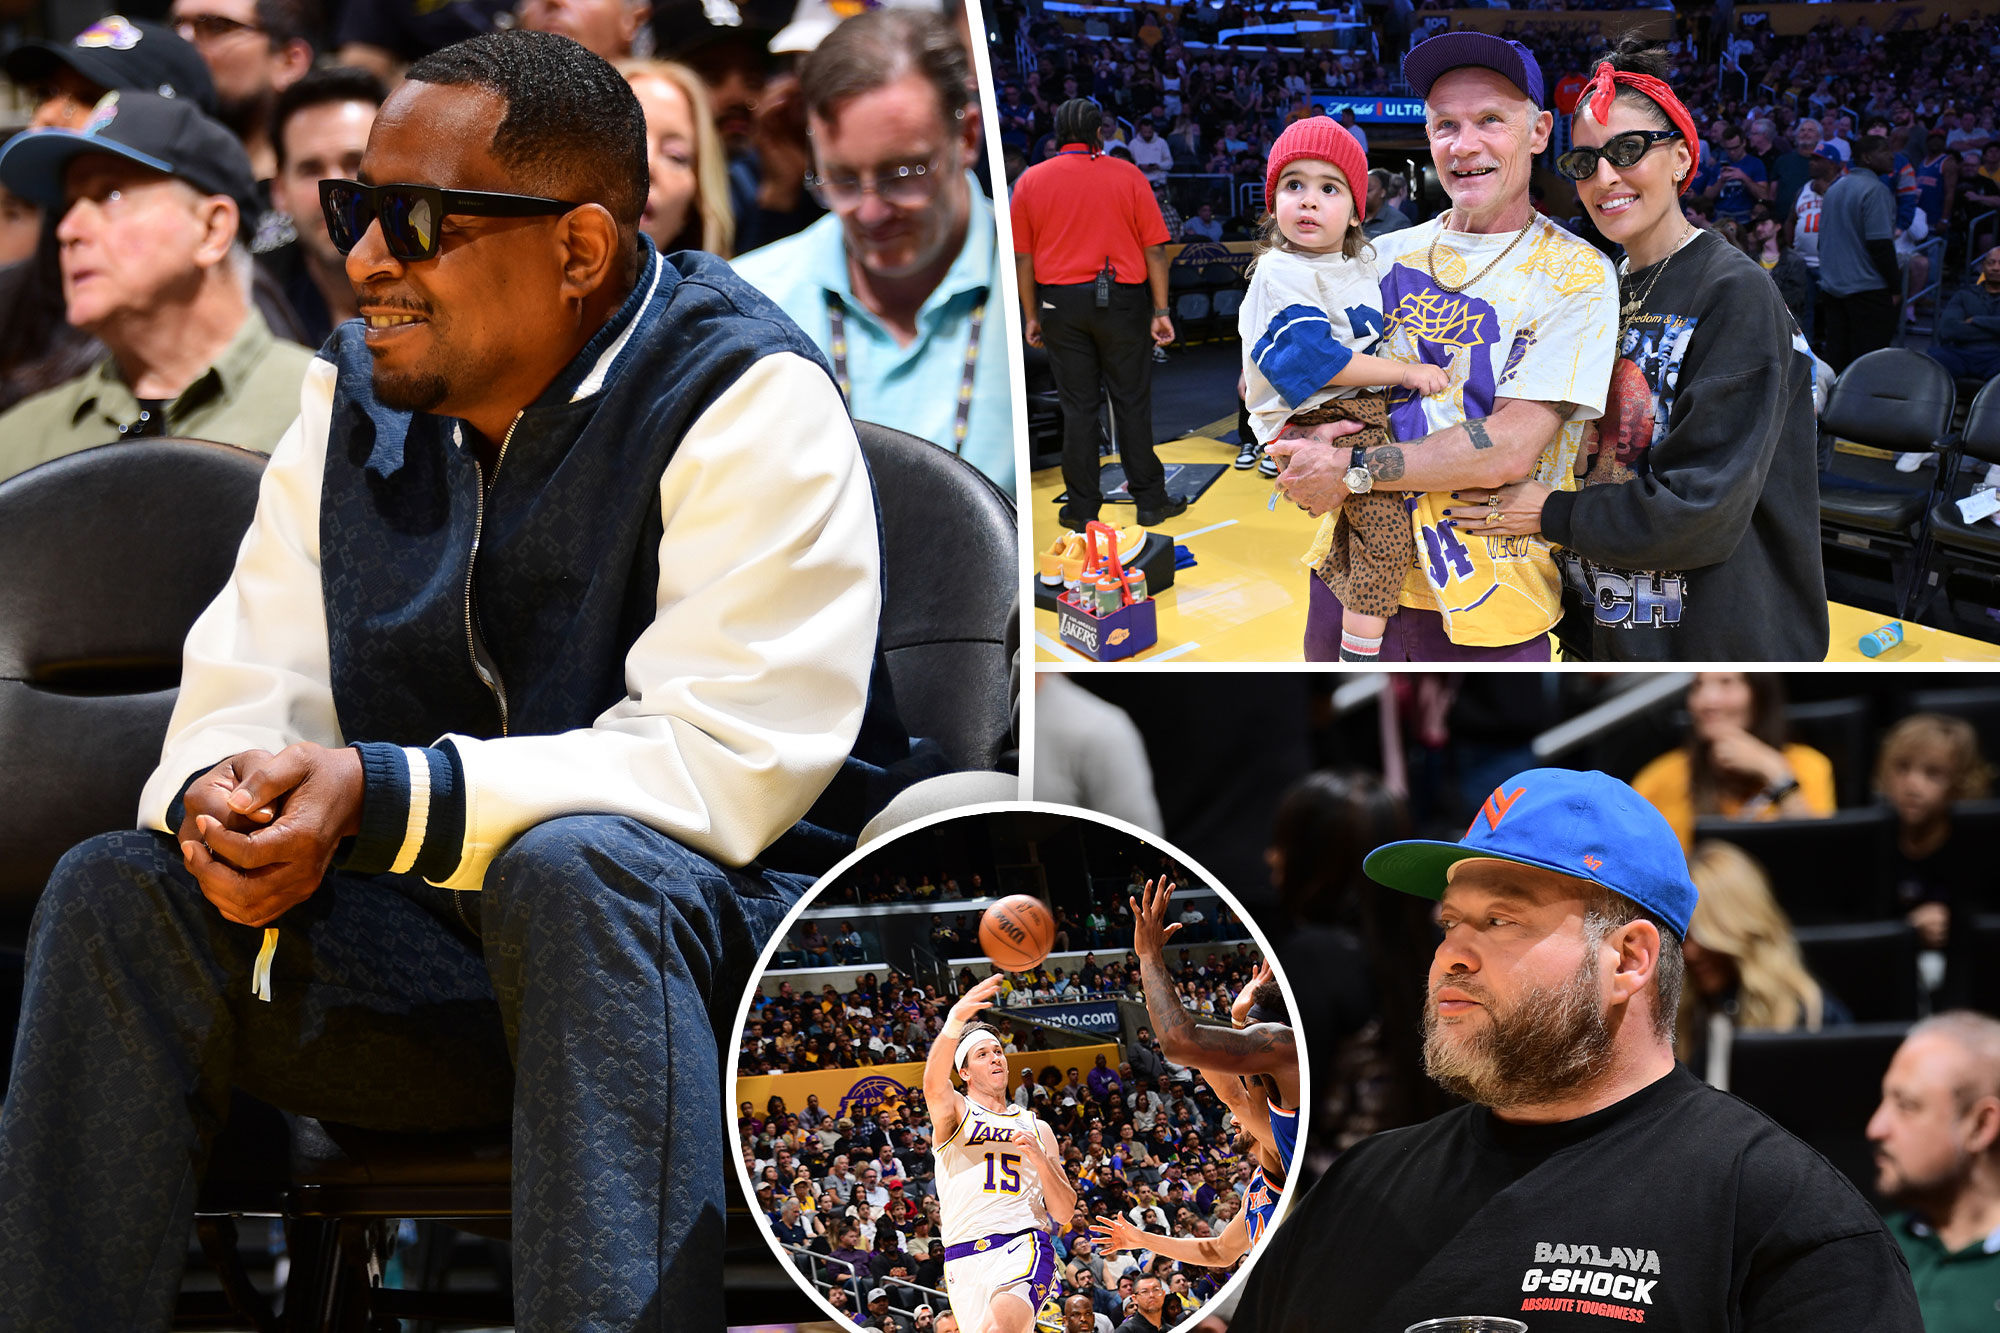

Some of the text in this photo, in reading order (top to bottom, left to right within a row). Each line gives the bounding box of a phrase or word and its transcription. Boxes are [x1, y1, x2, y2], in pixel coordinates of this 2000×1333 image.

[1663, 314, 1672, 324] &
[1060, 612, 1100, 653] LAKERS
[863, 1096, 882, 1105] LOS
[983, 1151, 1022, 1196] 15
[1533, 1241, 1661, 1275] BAKLAVA
[1521, 1268, 1658, 1305] G-SHOCK
[1520, 1297, 1575, 1312] ABSOLUTE
